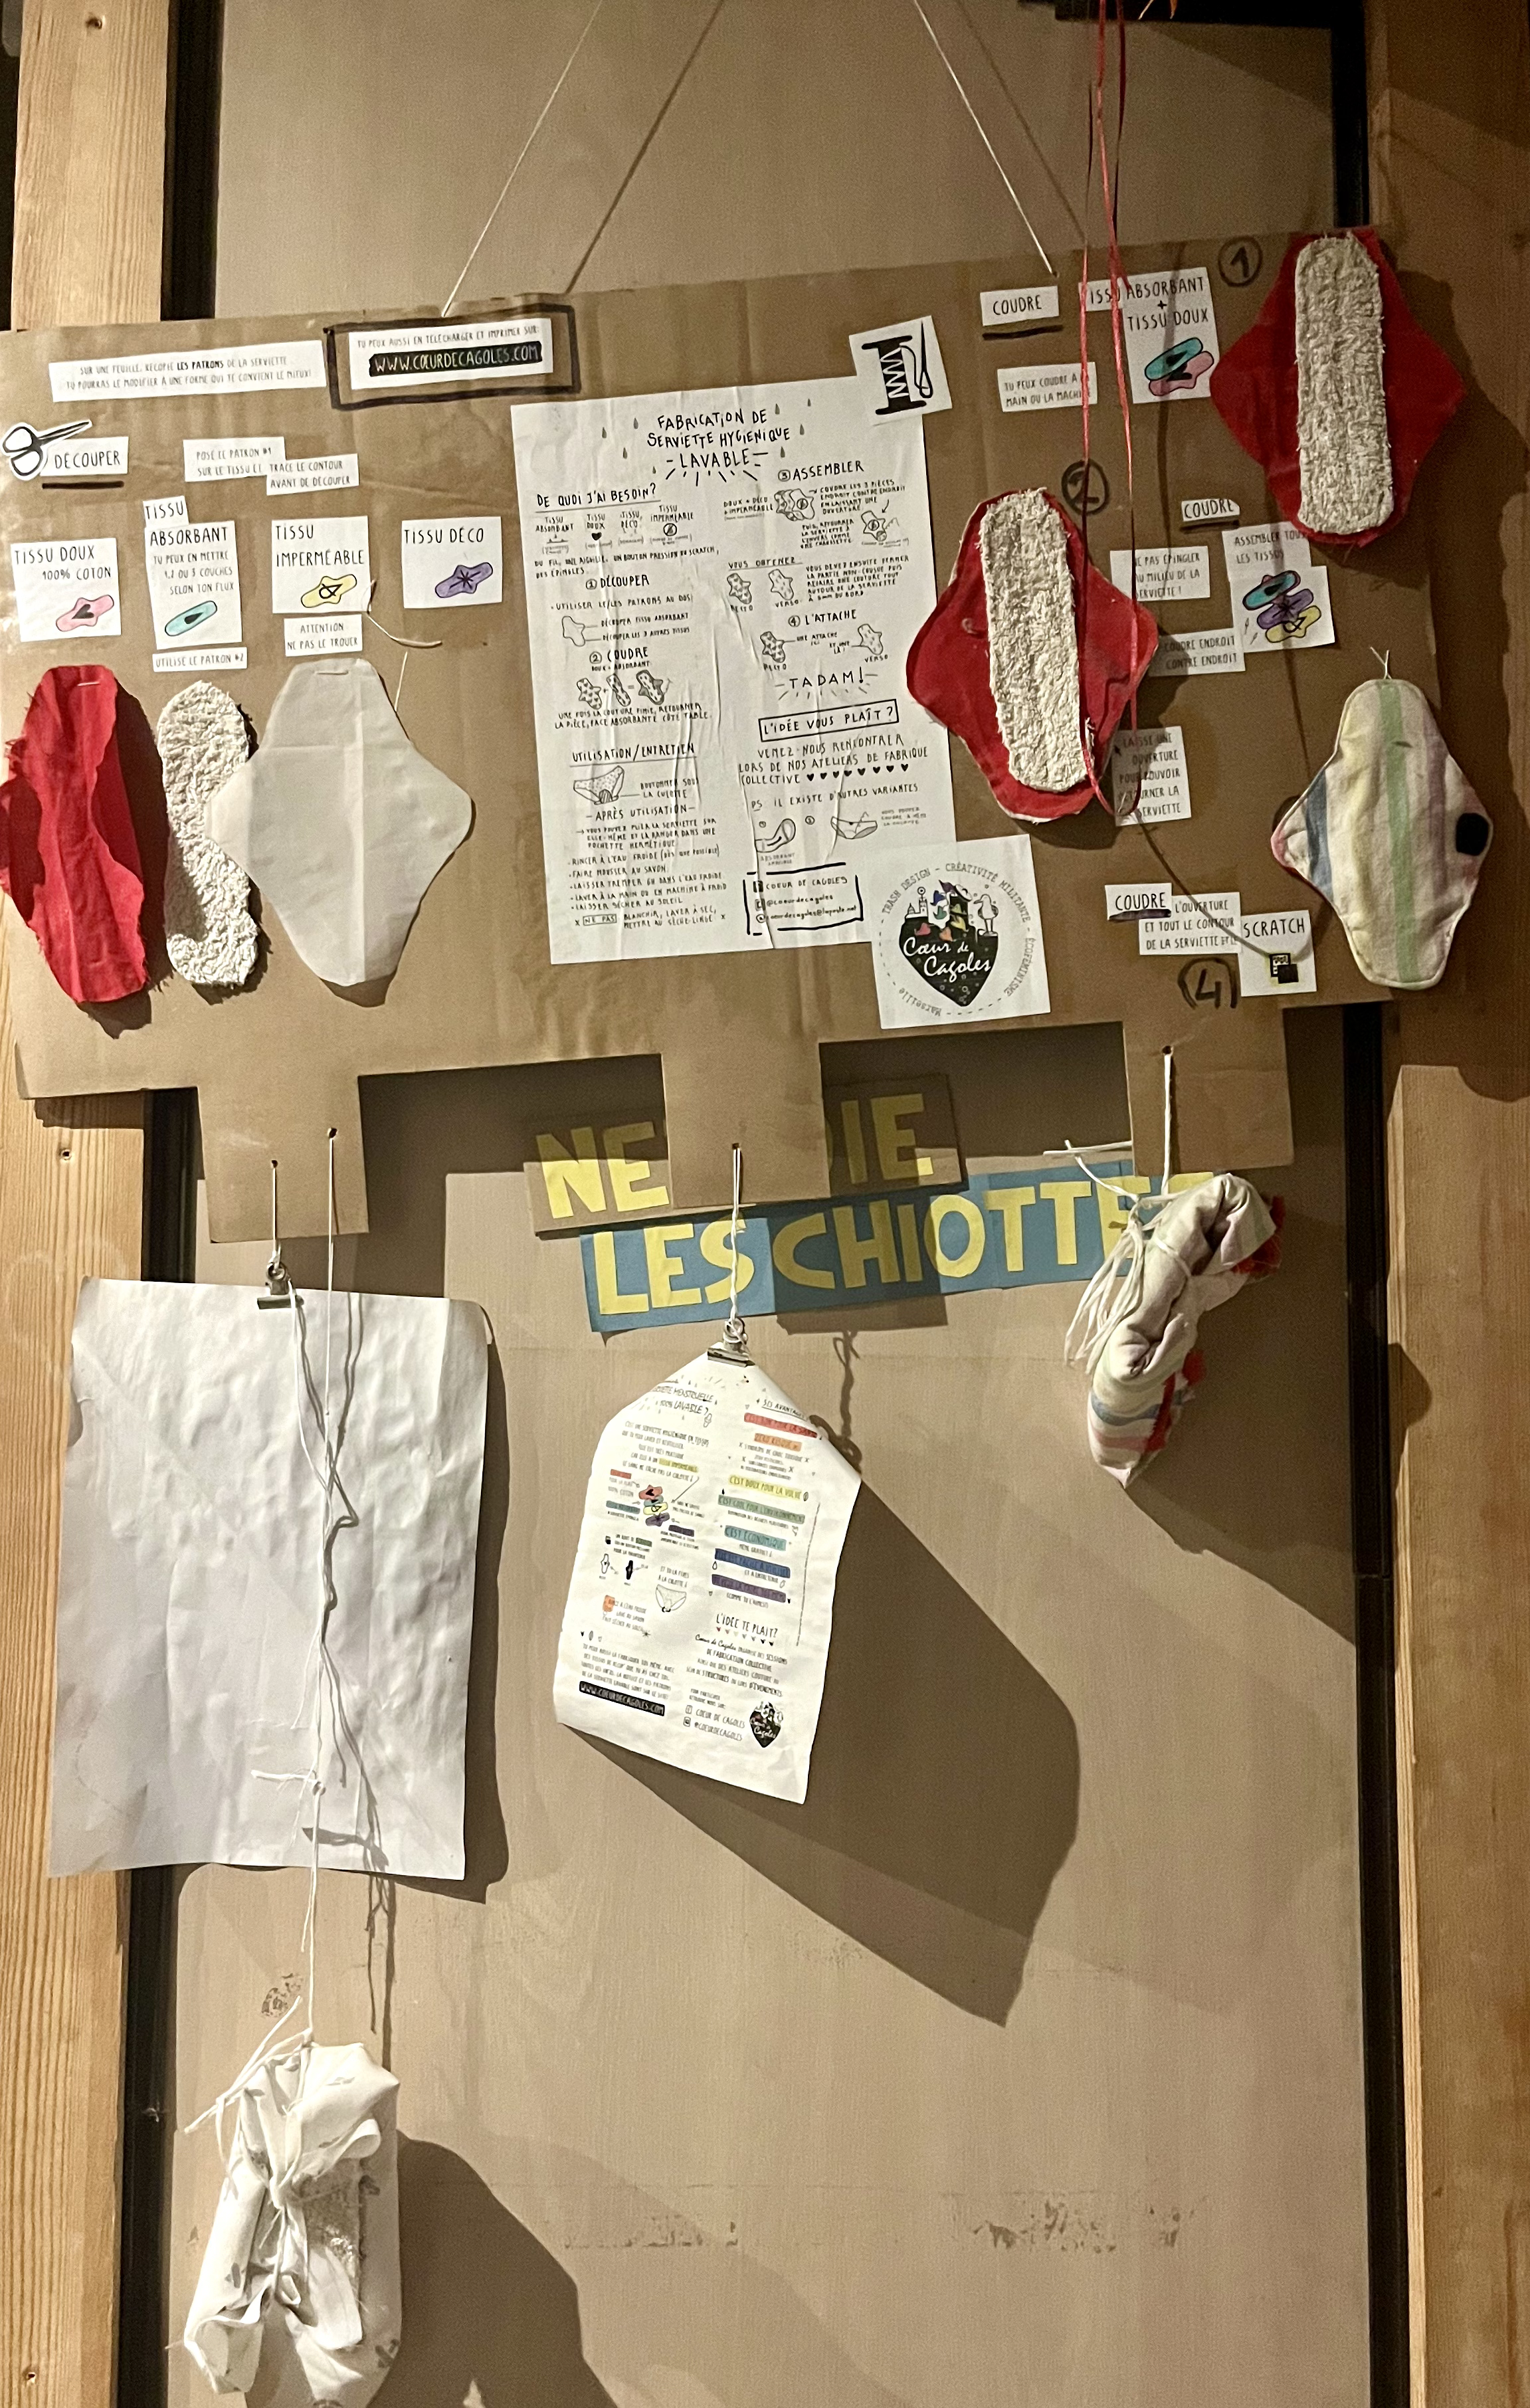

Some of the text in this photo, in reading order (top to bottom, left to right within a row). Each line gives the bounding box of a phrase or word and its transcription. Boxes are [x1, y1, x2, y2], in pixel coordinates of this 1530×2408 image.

[1127, 277, 1204, 300] ABSORBANT
[993, 294, 1042, 315] COUDRE
[1128, 308, 1208, 331] TISSU DOUX
[177, 361, 188, 371] LES
[192, 360, 223, 369] PATRONS
[1017, 379, 1035, 390] PEUX
[1040, 374, 1068, 386] COUDRE
[1006, 397, 1026, 407] MAIN
[1057, 390, 1090, 401] MACHIE
[657, 409, 767, 429] FABRICATION DE
[647, 431, 714, 449] SERVIETTE
[229, 449, 259, 459] PATRON
[198, 466, 213, 476] SUR
[228, 465, 248, 474] TISSU
[270, 460, 342, 473] TRACE LE CONTOUR
[793, 460, 864, 481] ASSEMBLER
[271, 477, 296, 488] AVANT
[300, 476, 308, 487] DE
[537, 494, 549, 507] DE
[558, 492, 581, 506] QUOI
[587, 491, 605, 504] J'AI
[145, 501, 183, 520] TISSU
[1184, 500, 1234, 519] COUDRE
[150, 527, 227, 546] ABSORBANT
[276, 525, 314, 539] TISSU
[405, 526, 484, 544] TISSU DÉCO
[1234, 532, 1280, 546] ASSEMBLER
[14, 545, 94, 565] TISSU DOUX
[166, 554, 184, 563] PEUX
[188, 553, 197, 562] EN
[276, 549, 364, 567] IMPERMÉABLE
[1145, 555, 1159, 566] PAS
[1236, 555, 1248, 564] LES
[76, 567, 111, 580] COTON
[178, 569, 188, 578] OU
[1147, 569, 1200, 582] MILIEU DE LA
[170, 585, 193, 595] SELON
[216, 583, 233, 592] FLUX
[805, 609, 856, 625] L'ATTACHE
[301, 623, 343, 633] ATTENTION
[300, 640, 314, 649] PAS
[319, 639, 326, 648] LE
[330, 637, 358, 647] TROUER
[1164, 636, 1234, 652] COUDRE ENDROIT
[201, 655, 231, 664] PATRON
[607, 647, 648, 662] COUDRE
[1166, 654, 1236, 669] CONTRE ENDROIT
[807, 716, 834, 729] VOUS
[758, 734, 904, 759] VENEZ NOUS RENCONTRER
[771, 762, 781, 771] DE
[788, 760, 807, 770] NOS
[867, 753, 878, 762] DE
[885, 746, 928, 761] FABRIQUE
[1132, 750, 1177, 765] OUVERTURE
[1143, 768, 1180, 781] POUVOIR
[1169, 785, 1179, 796] LA
[631, 805, 686, 817] UTILISATION
[882, 890, 900, 914] TRASH
[901, 868, 930, 890] DESIGN
[945, 862, 998, 882] CRÉATIVITÉ
[999, 880, 1030, 922] MILITANTE
[1115, 892, 1227, 913] COUDRE L'OUVERTURE
[1145, 918, 1234, 932] ET TOUT LE CONTOUR
[1243, 918, 1304, 938] SCRATCH
[957, 942, 969, 952] de
[1147, 936, 1218, 950] DE LA SERVIETTE
[924, 952, 991, 982] Cagoles
[899, 987, 942, 1017] Marseille
[592, 1173, 1214, 1314] LES CHIOTTE
